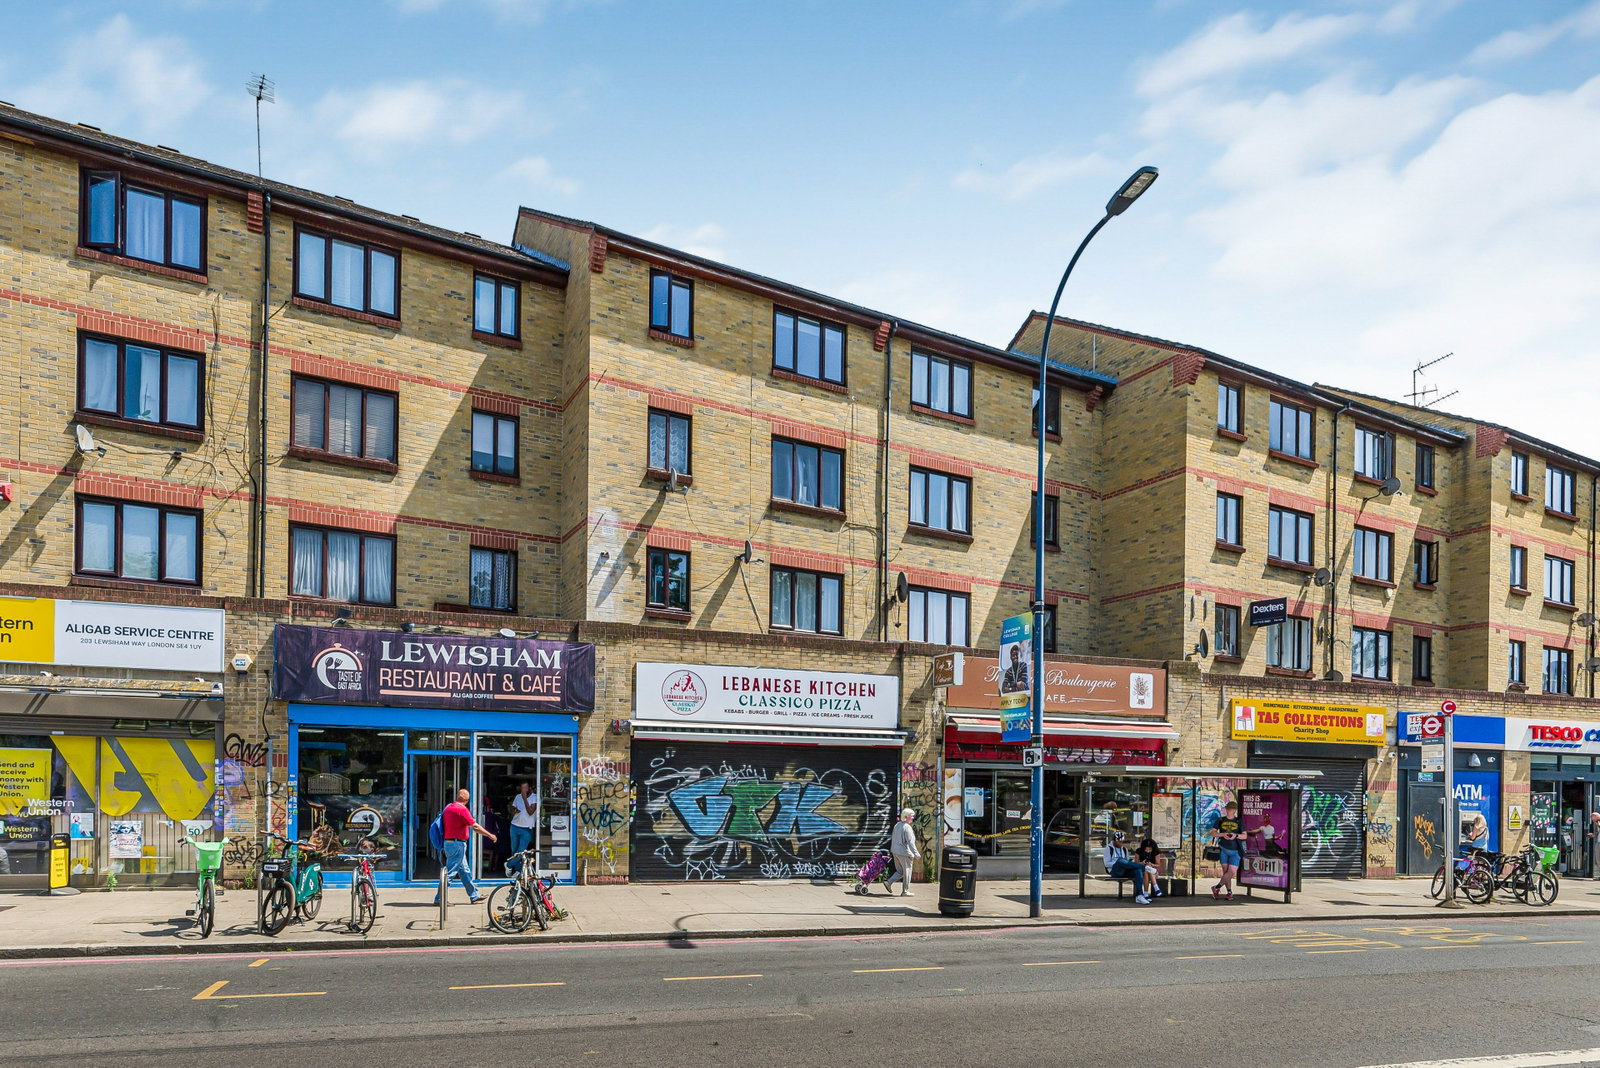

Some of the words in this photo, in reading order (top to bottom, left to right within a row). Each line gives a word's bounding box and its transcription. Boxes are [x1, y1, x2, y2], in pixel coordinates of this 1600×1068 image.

[1252, 603, 1284, 614] Dexters
[65, 623, 111, 635] ALIGAB
[114, 626, 165, 638] SERVICE
[167, 629, 214, 640] CENTRE
[380, 640, 562, 670] LEWISHAM
[338, 671, 354, 682] TASTE
[354, 672, 362, 682] OF
[380, 668, 496, 692] RESTAURANT
[502, 673, 516, 692] &
[520, 671, 562, 694] CAFÉ
[1046, 669, 1116, 694] Boulangerie
[338, 682, 348, 690] EAST
[348, 682, 362, 690] AFRICA
[722, 676, 801, 694] LEBANESE
[810, 680, 876, 697] KITCHEN
[738, 694, 814, 708] CLASSICO
[820, 698, 862, 712] PIZZA
[1443, 702, 1453, 713] C
[1284, 713, 1364, 728] COLLECTIONS
[1528, 724, 1583, 742] TESCO
[28, 798, 75, 807] Western
[28, 807, 61, 816] Union
